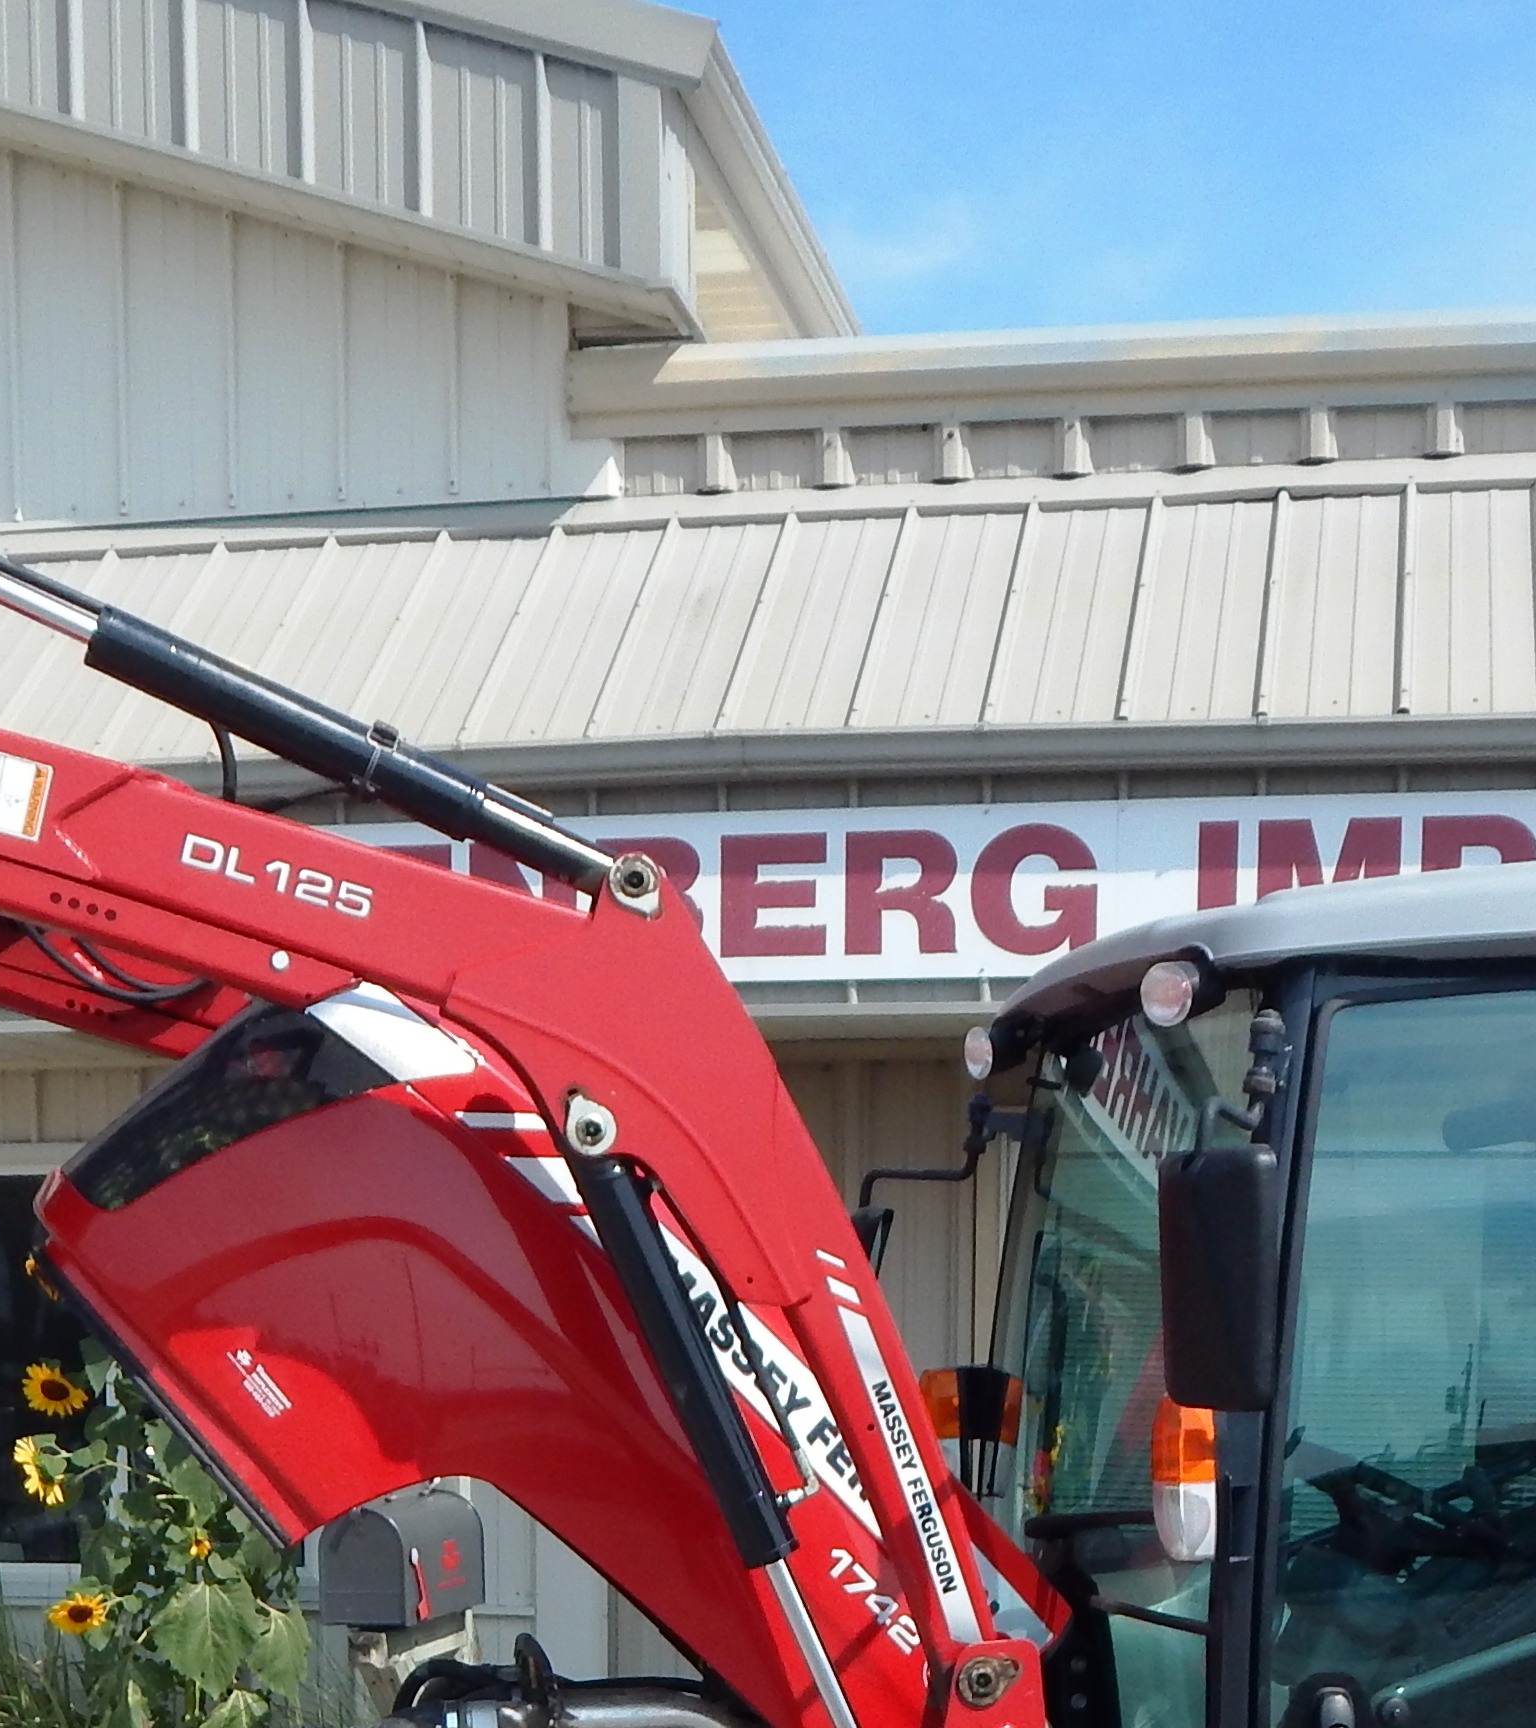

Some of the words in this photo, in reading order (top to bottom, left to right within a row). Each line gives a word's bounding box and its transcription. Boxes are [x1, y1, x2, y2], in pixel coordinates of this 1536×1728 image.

[872, 1379, 917, 1470] MASSEY
[907, 1477, 958, 1595] FERGUSON
[828, 1547, 922, 1656] 1742
